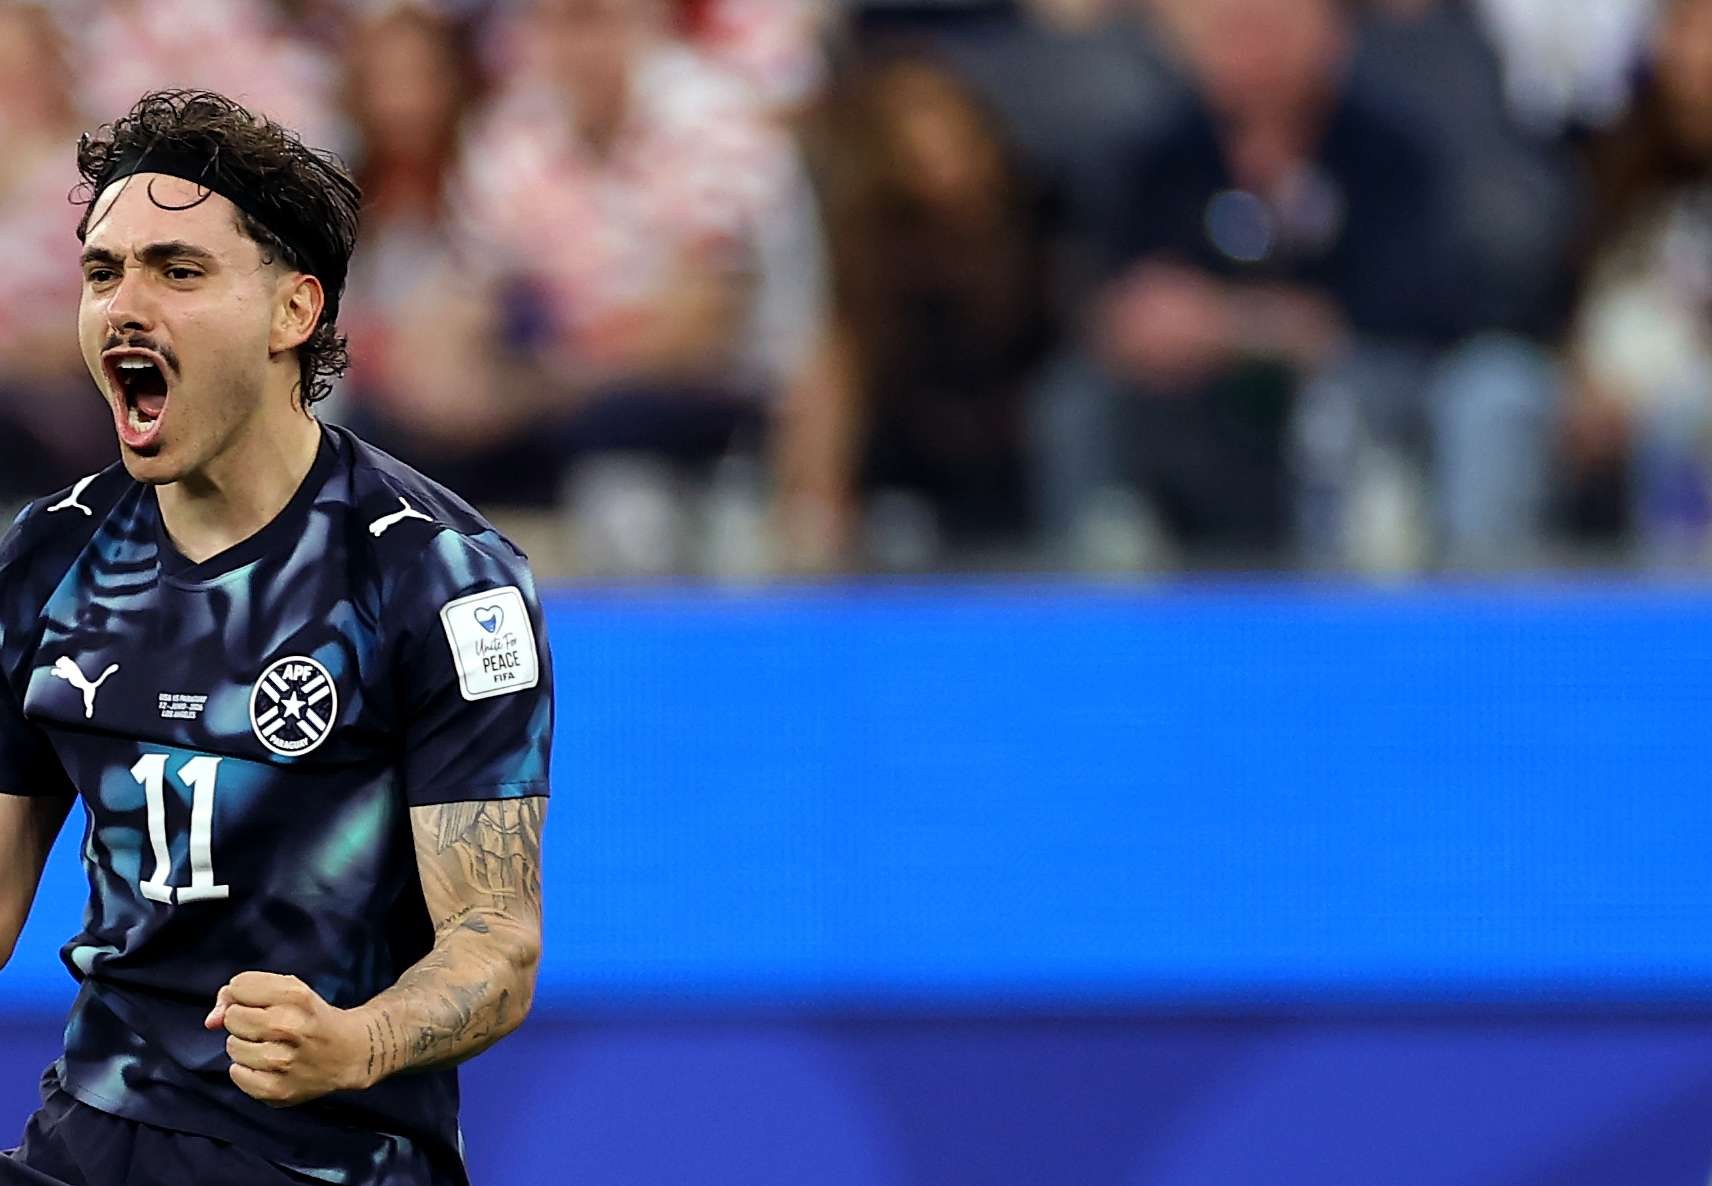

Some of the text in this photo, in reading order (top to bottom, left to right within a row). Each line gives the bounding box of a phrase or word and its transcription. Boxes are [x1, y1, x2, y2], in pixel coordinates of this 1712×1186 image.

[475, 632, 518, 656] Unite For
[282, 664, 314, 681] APF
[482, 650, 520, 673] PEACE
[493, 672, 516, 683] FIFA
[130, 753, 230, 905] 11
